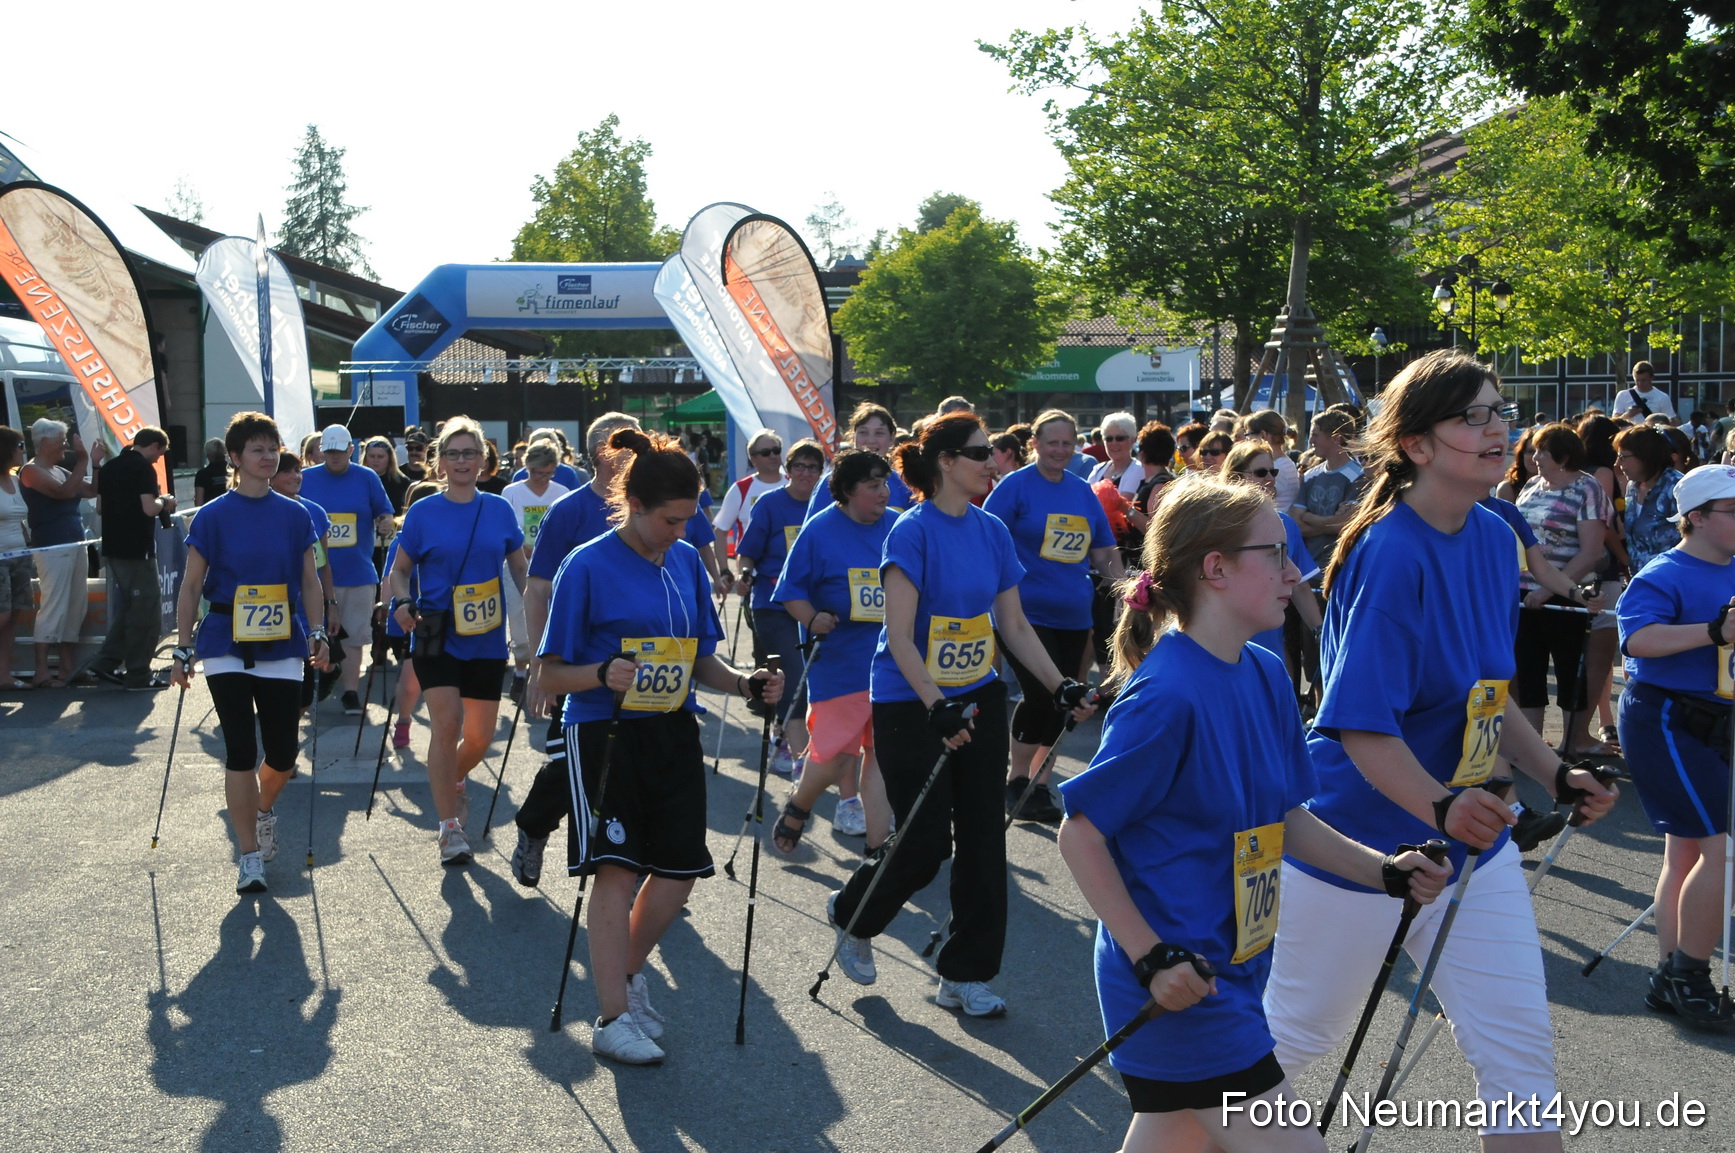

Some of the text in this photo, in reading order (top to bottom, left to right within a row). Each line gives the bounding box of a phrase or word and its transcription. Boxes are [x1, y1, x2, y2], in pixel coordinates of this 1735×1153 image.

[545, 295, 621, 310] firmenlauf
[400, 317, 441, 330] Fischer
[1136, 375, 1175, 383] Lammsbräu
[1052, 531, 1085, 551] 722
[243, 604, 284, 627] 725
[463, 597, 496, 623] 619
[937, 640, 986, 669] 655
[636, 663, 684, 694] 663
[1245, 868, 1278, 927] 706
